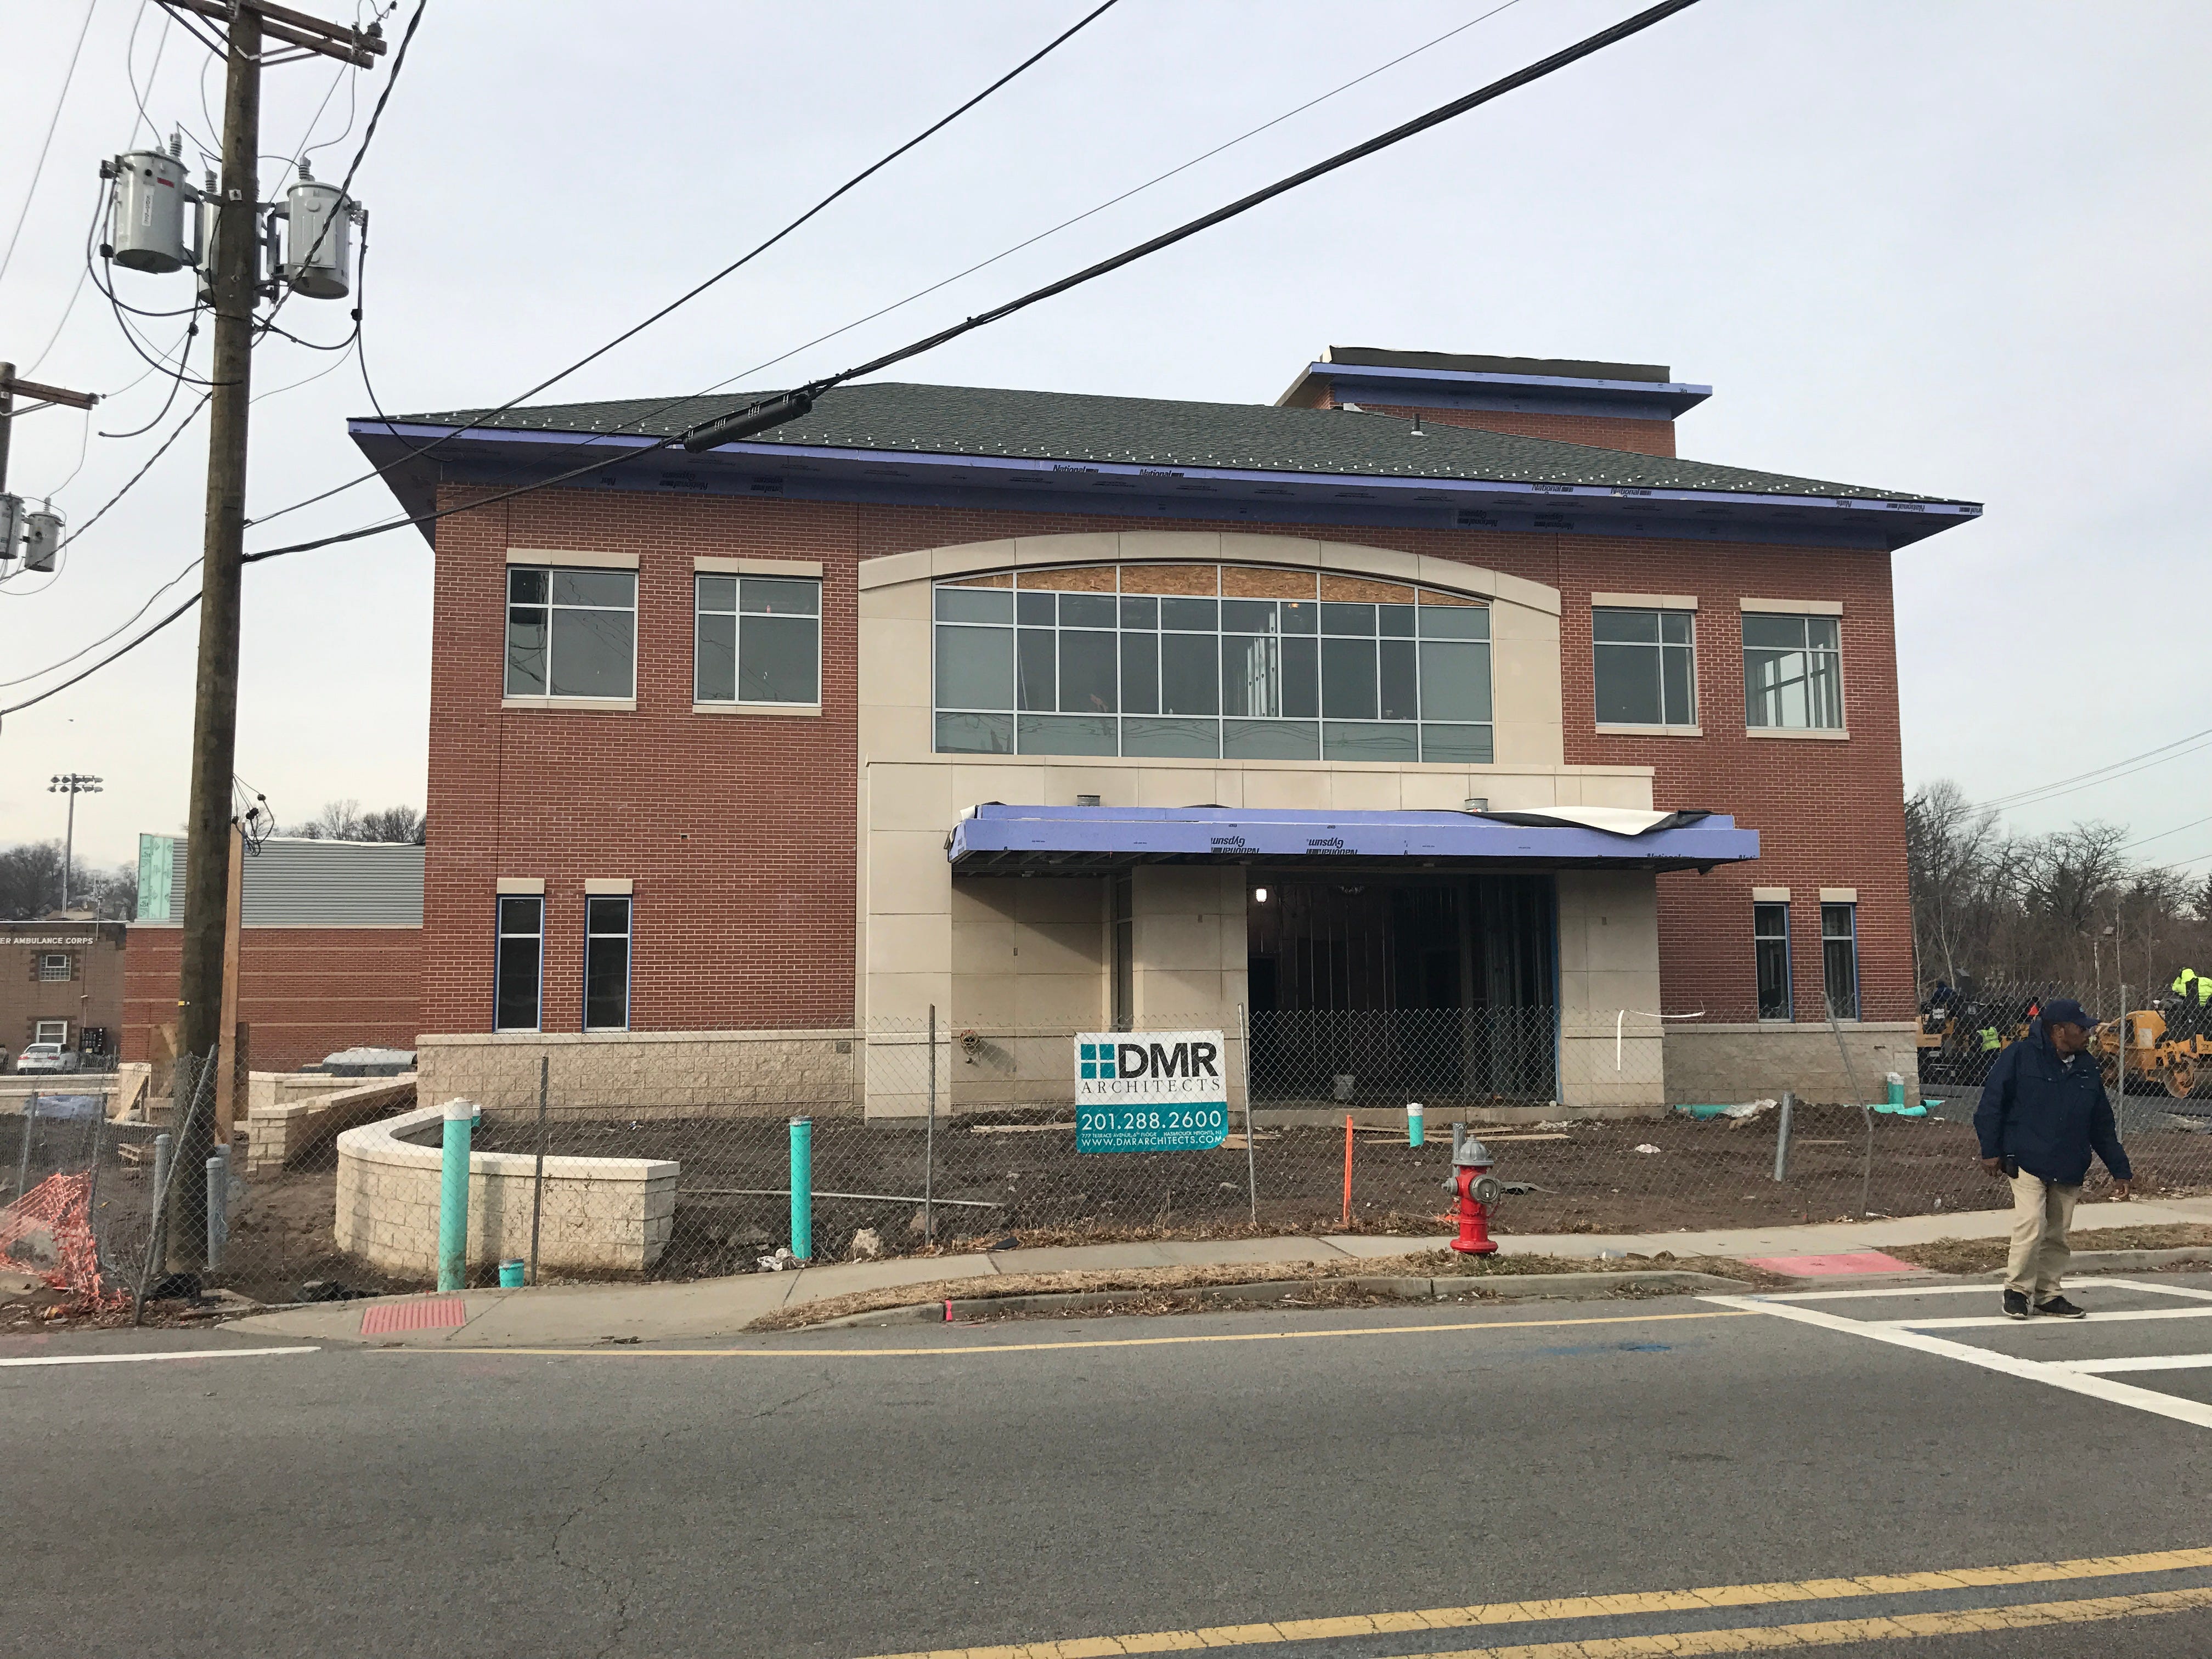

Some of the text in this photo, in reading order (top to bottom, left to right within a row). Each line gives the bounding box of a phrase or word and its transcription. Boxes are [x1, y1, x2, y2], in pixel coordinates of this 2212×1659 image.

[1053, 465, 1086, 473] National
[1139, 469, 1172, 477] National
[1531, 483, 1562, 492] National
[1897, 503, 1926, 512] National
[1211, 836, 1245, 847] Gypsum
[1308, 837, 1344, 849] Gypsum
[1118, 1042, 1219, 1079] DMR
[1081, 1078, 1220, 1093] ARCHITECTS
[1081, 1110, 1221, 1130] 201.288.2600
[1081, 1136, 1222, 1147] WWW.DMRARCHITECTS.COM
